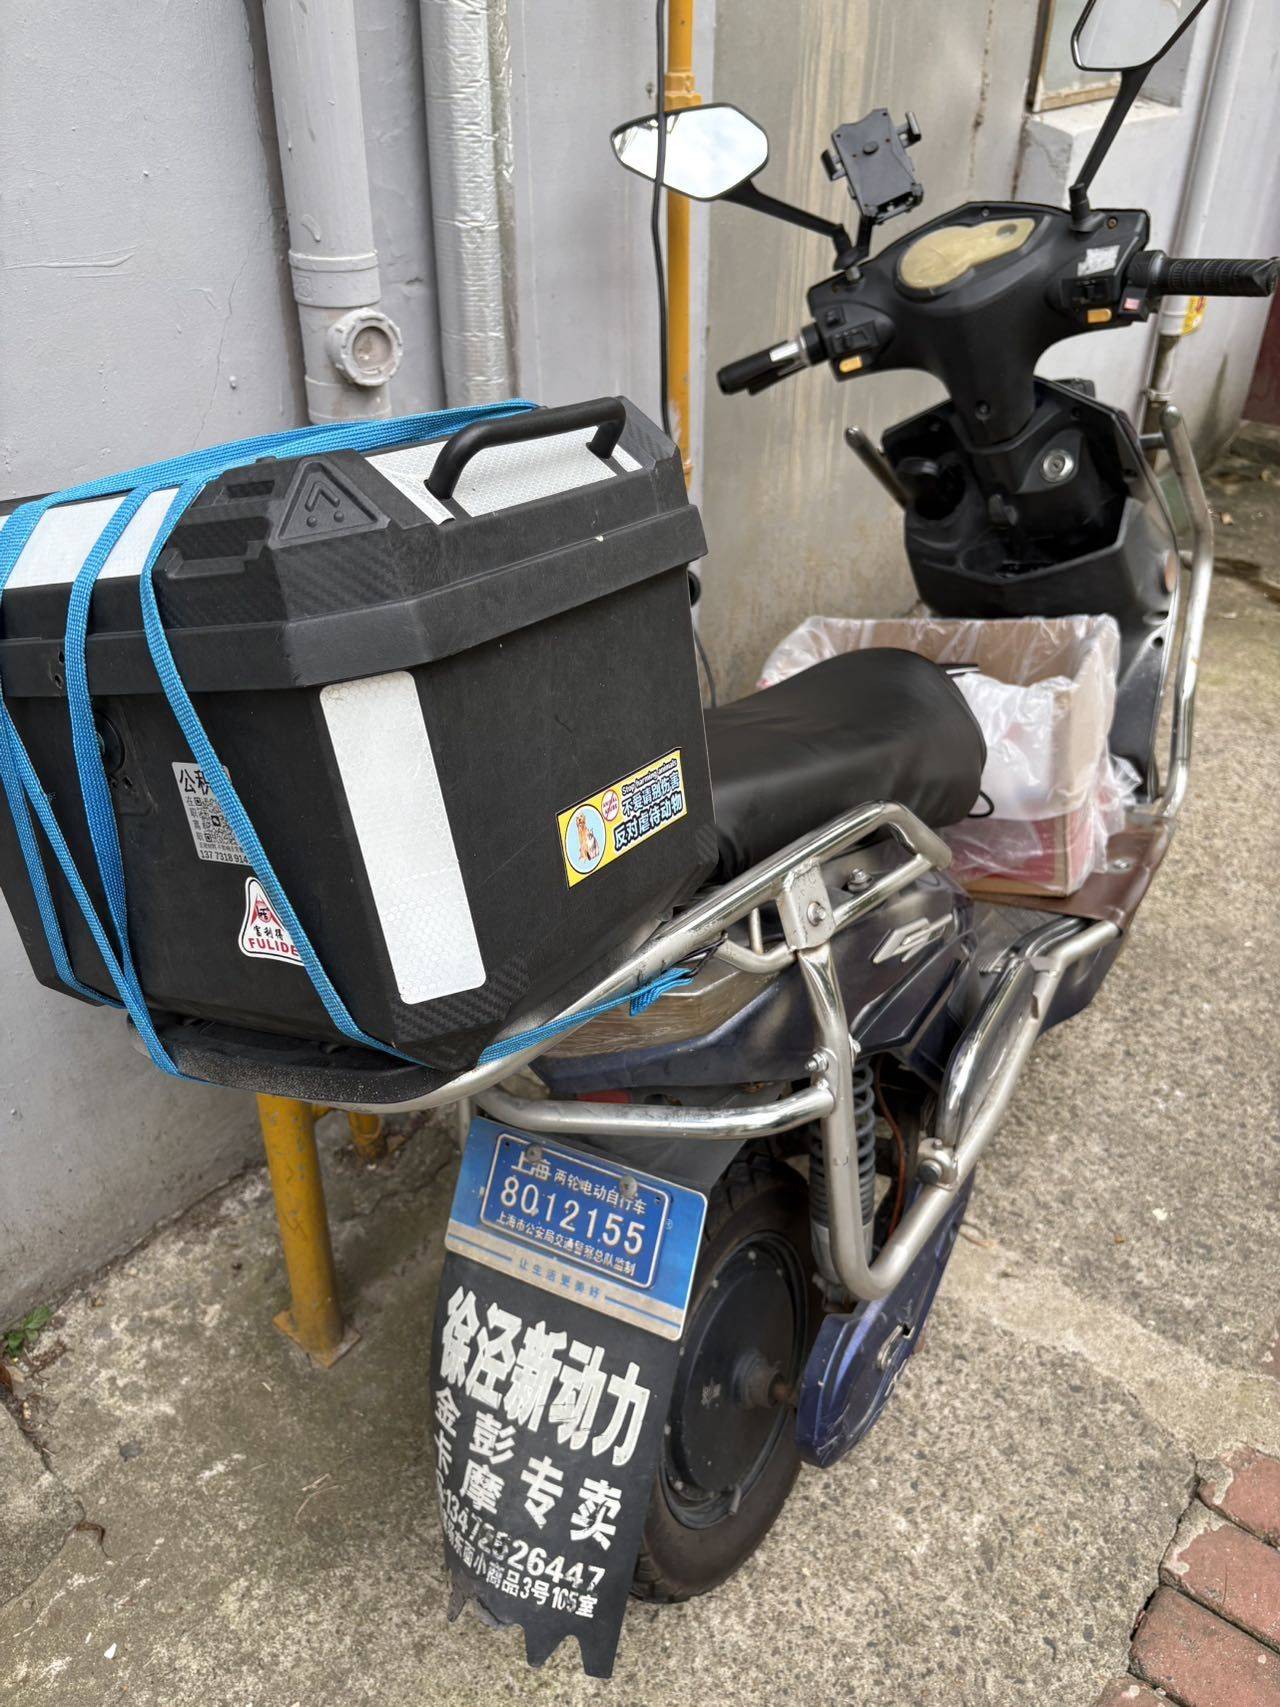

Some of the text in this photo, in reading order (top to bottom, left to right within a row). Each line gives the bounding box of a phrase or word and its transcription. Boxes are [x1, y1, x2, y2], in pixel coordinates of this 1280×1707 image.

[613, 791, 684, 851] 反对虐待动物
[248, 937, 300, 957] FULIDE
[500, 1175, 647, 1255] 8012155
[511, 1151, 648, 1215] 上海 两轮电动自行车
[496, 1211, 637, 1277] 上海市公安局交通警察总队监制
[440, 1286, 651, 1466] 徐泾新动力
[520, 1455, 623, 1551] 专卖
